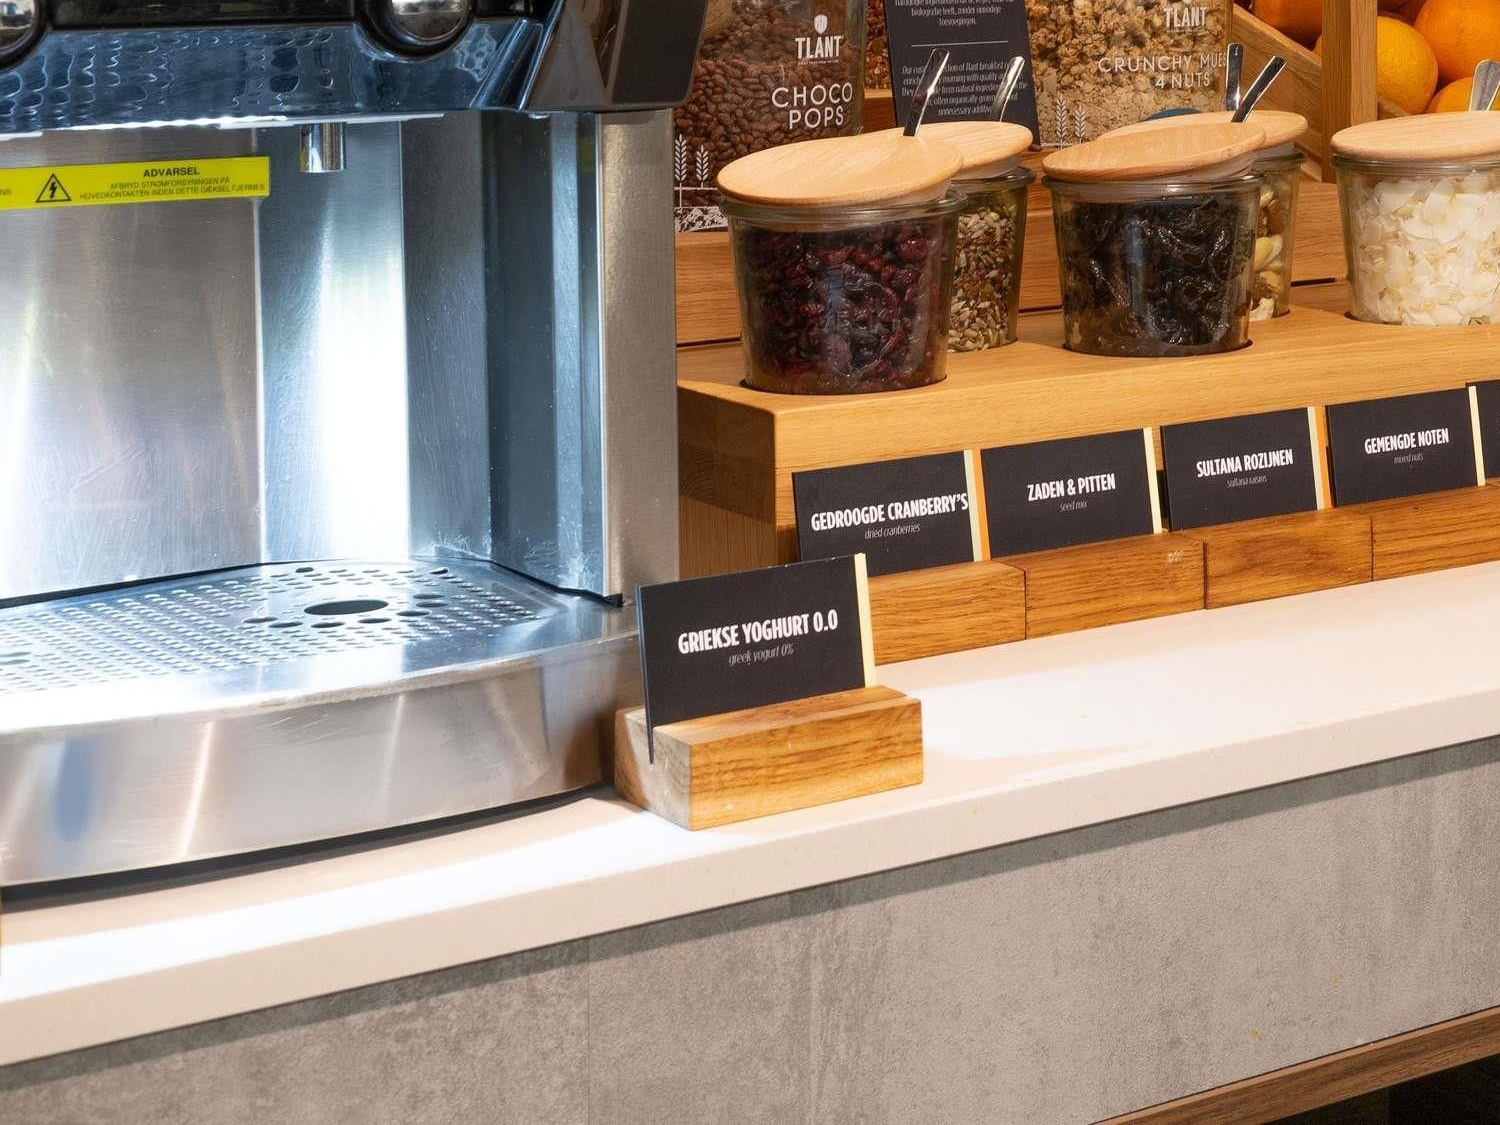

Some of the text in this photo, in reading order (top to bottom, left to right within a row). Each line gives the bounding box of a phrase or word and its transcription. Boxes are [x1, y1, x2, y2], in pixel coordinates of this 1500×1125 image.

[1164, 6, 1208, 28] TLANT
[795, 35, 842, 59] TLANT
[1098, 55, 1192, 73] CRUNCHY
[1154, 72, 1211, 89] 4 NUTS
[772, 82, 853, 108] CHOCO
[789, 105, 844, 130] POPS
[144, 167, 200, 177] ADVARSEL
[1364, 427, 1450, 455] GEMENGDE NOTEN
[1196, 449, 1294, 478] SULTANA ROZIJNEN
[1027, 473, 1116, 501] ZADEN & PITTEN
[810, 493, 969, 532] GEDROOGDE CRANBERRY'S
[1060, 501, 1088, 512] seed mix
[864, 523, 921, 540] dried cranberries
[678, 609, 839, 655] GRIEKSE YOGHURT 0.0
[728, 643, 794, 667] greek yogurt 0%
